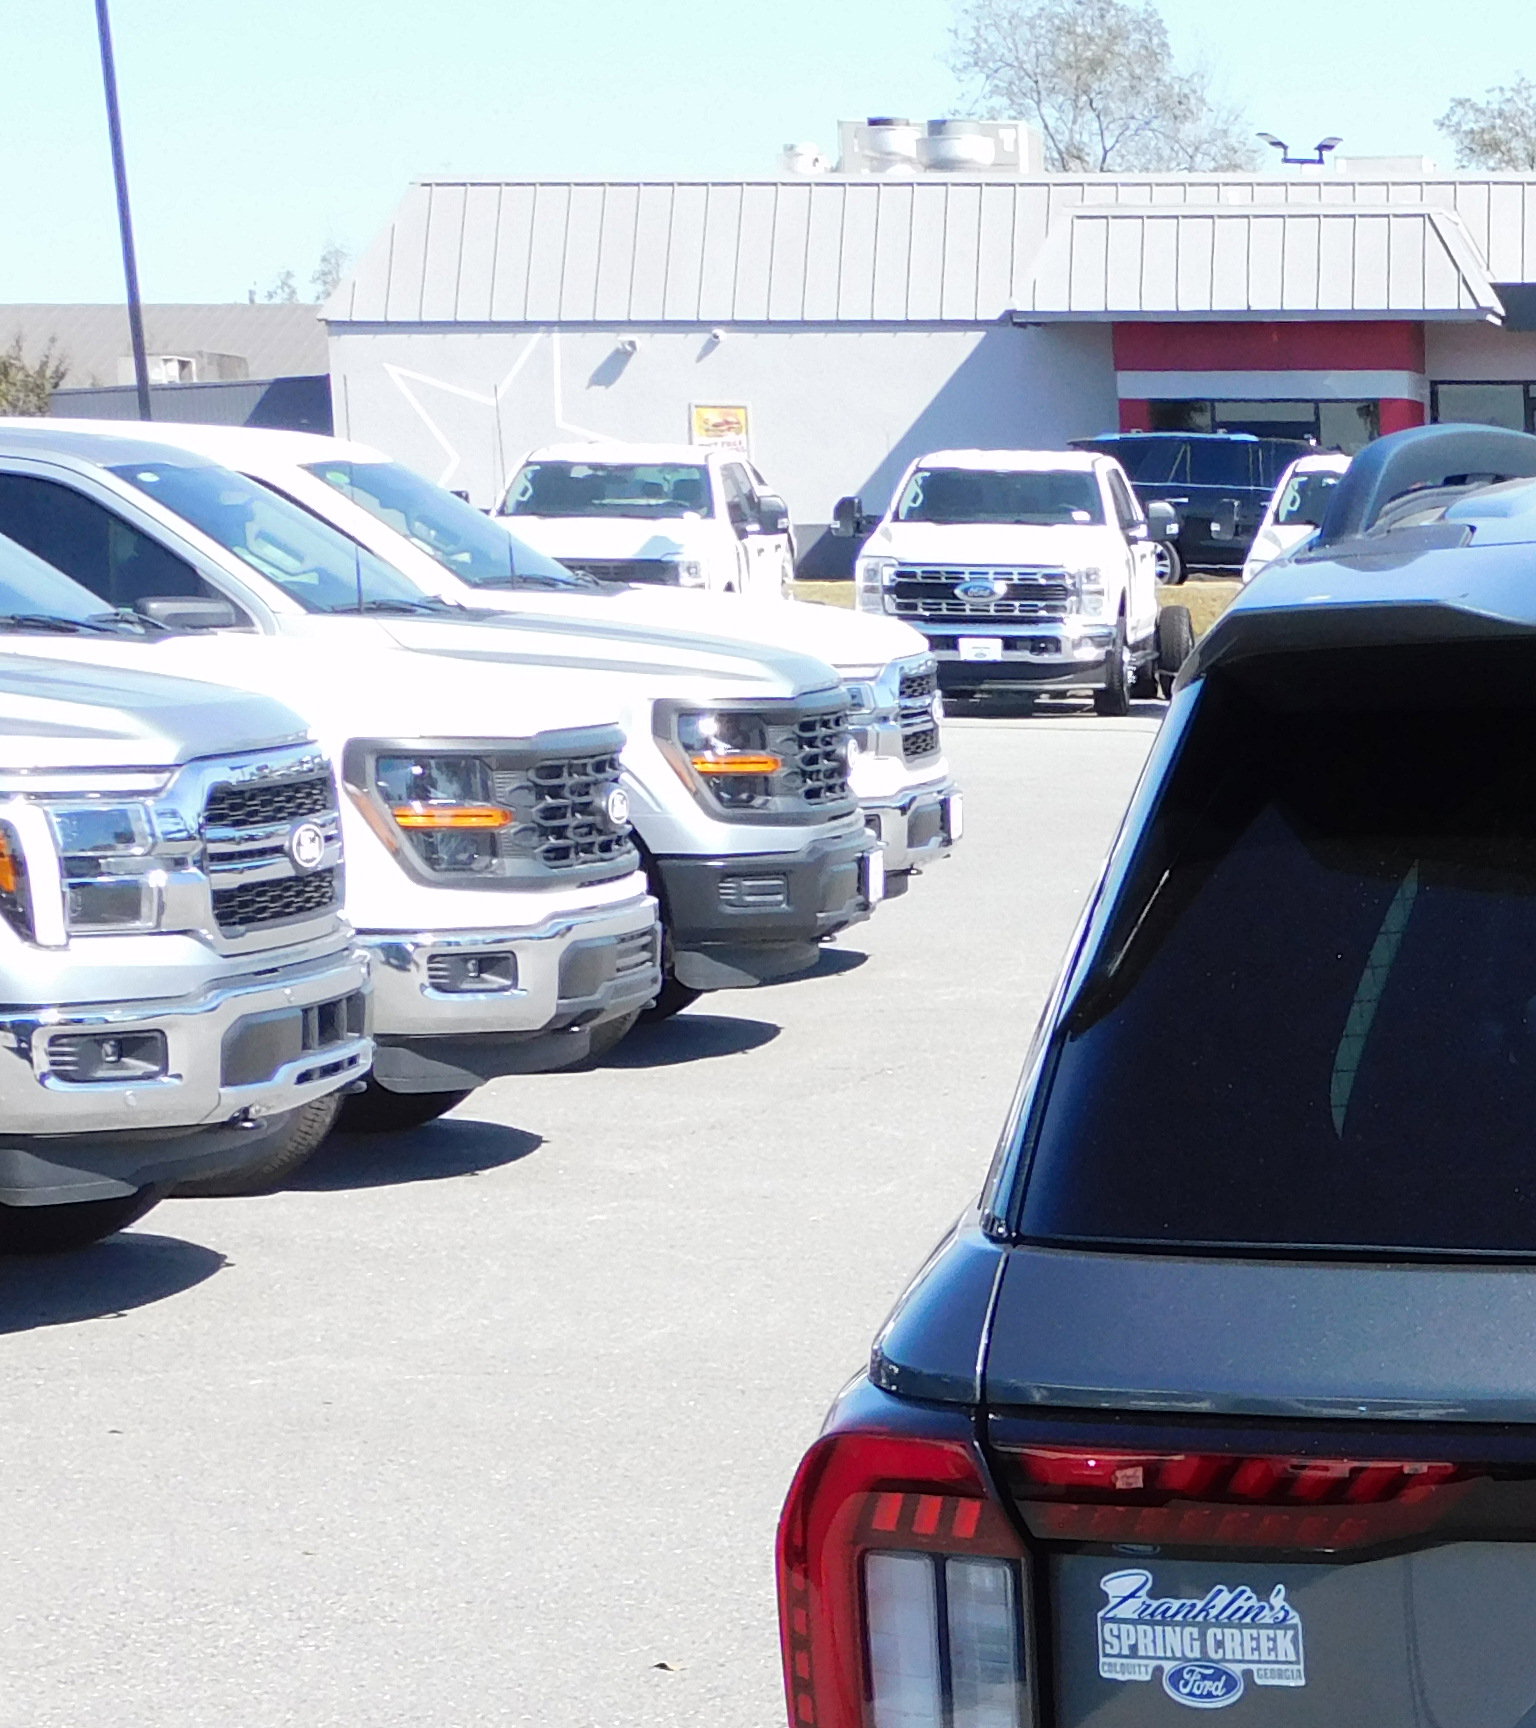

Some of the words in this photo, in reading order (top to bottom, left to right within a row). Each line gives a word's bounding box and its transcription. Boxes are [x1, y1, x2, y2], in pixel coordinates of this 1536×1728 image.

[1100, 1572, 1297, 1624] Franklin's
[1103, 1622, 1201, 1659] SPRING
[1206, 1626, 1297, 1662] CREEK
[1101, 1660, 1150, 1677] COLQUITT
[1178, 1665, 1227, 1697] Ford
[1256, 1667, 1301, 1681] GEORGIA
